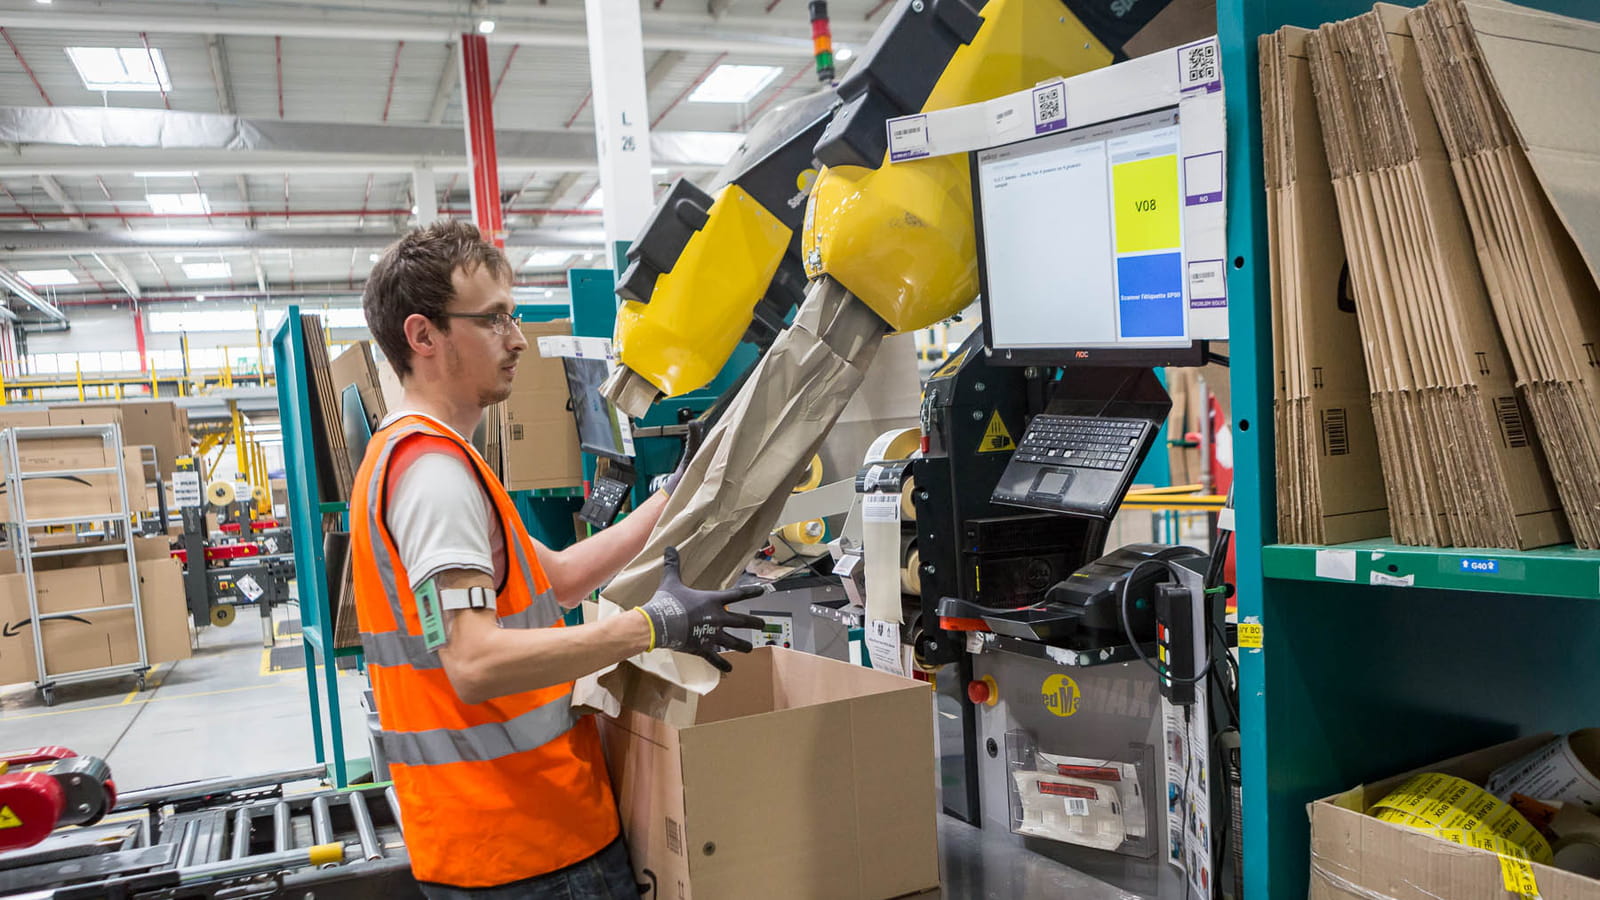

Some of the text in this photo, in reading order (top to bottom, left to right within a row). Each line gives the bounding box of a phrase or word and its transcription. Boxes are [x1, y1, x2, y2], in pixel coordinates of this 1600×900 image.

[1135, 199, 1157, 212] V08
[692, 623, 717, 638] HyFlex
[1432, 785, 1470, 818] HEAVY BOX
[1462, 800, 1497, 831] HEAVY BO
